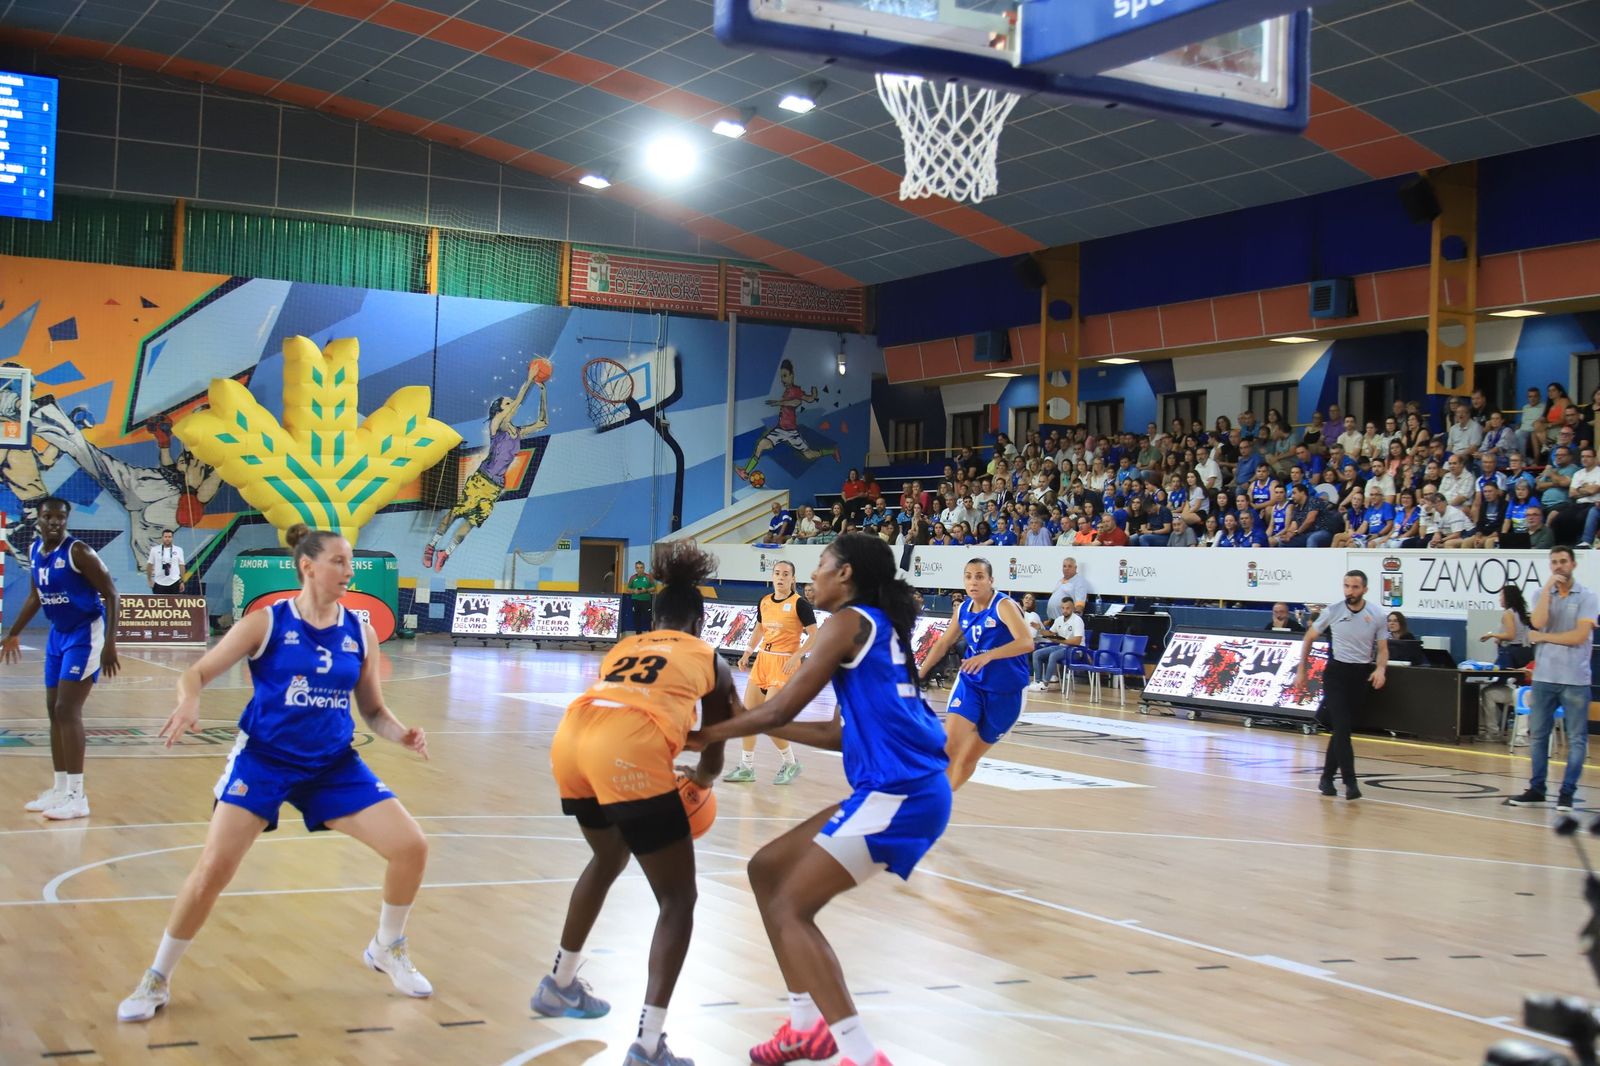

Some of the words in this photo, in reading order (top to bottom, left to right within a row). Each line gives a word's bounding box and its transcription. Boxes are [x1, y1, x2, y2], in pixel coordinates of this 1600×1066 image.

[615, 278, 635, 294] DE
[637, 280, 701, 300] ZAMORA
[789, 296, 848, 313] ZAMORA
[239, 559, 269, 569] ZAMORA
[351, 560, 373, 570] ENSE
[922, 562, 943, 572] ZAMORA
[1017, 564, 1041, 574] ZAMORA
[1128, 566, 1157, 577] ZAMORA
[1258, 568, 1292, 581] ZAMORA
[1418, 558, 1543, 595] ZAMORA
[148, 598, 172, 608] DEL
[174, 598, 206, 608] VINO
[1418, 598, 1496, 611] AYUNTAMIENTO
[134, 609, 191, 619] ZAMORA
[117, 619, 159, 627] ENOMINACIÓN
[316, 645, 334, 674] 3
[603, 655, 668, 685] 23
[1155, 669, 1187, 679] TIERRA
[1237, 676, 1272, 688] TIERRA
